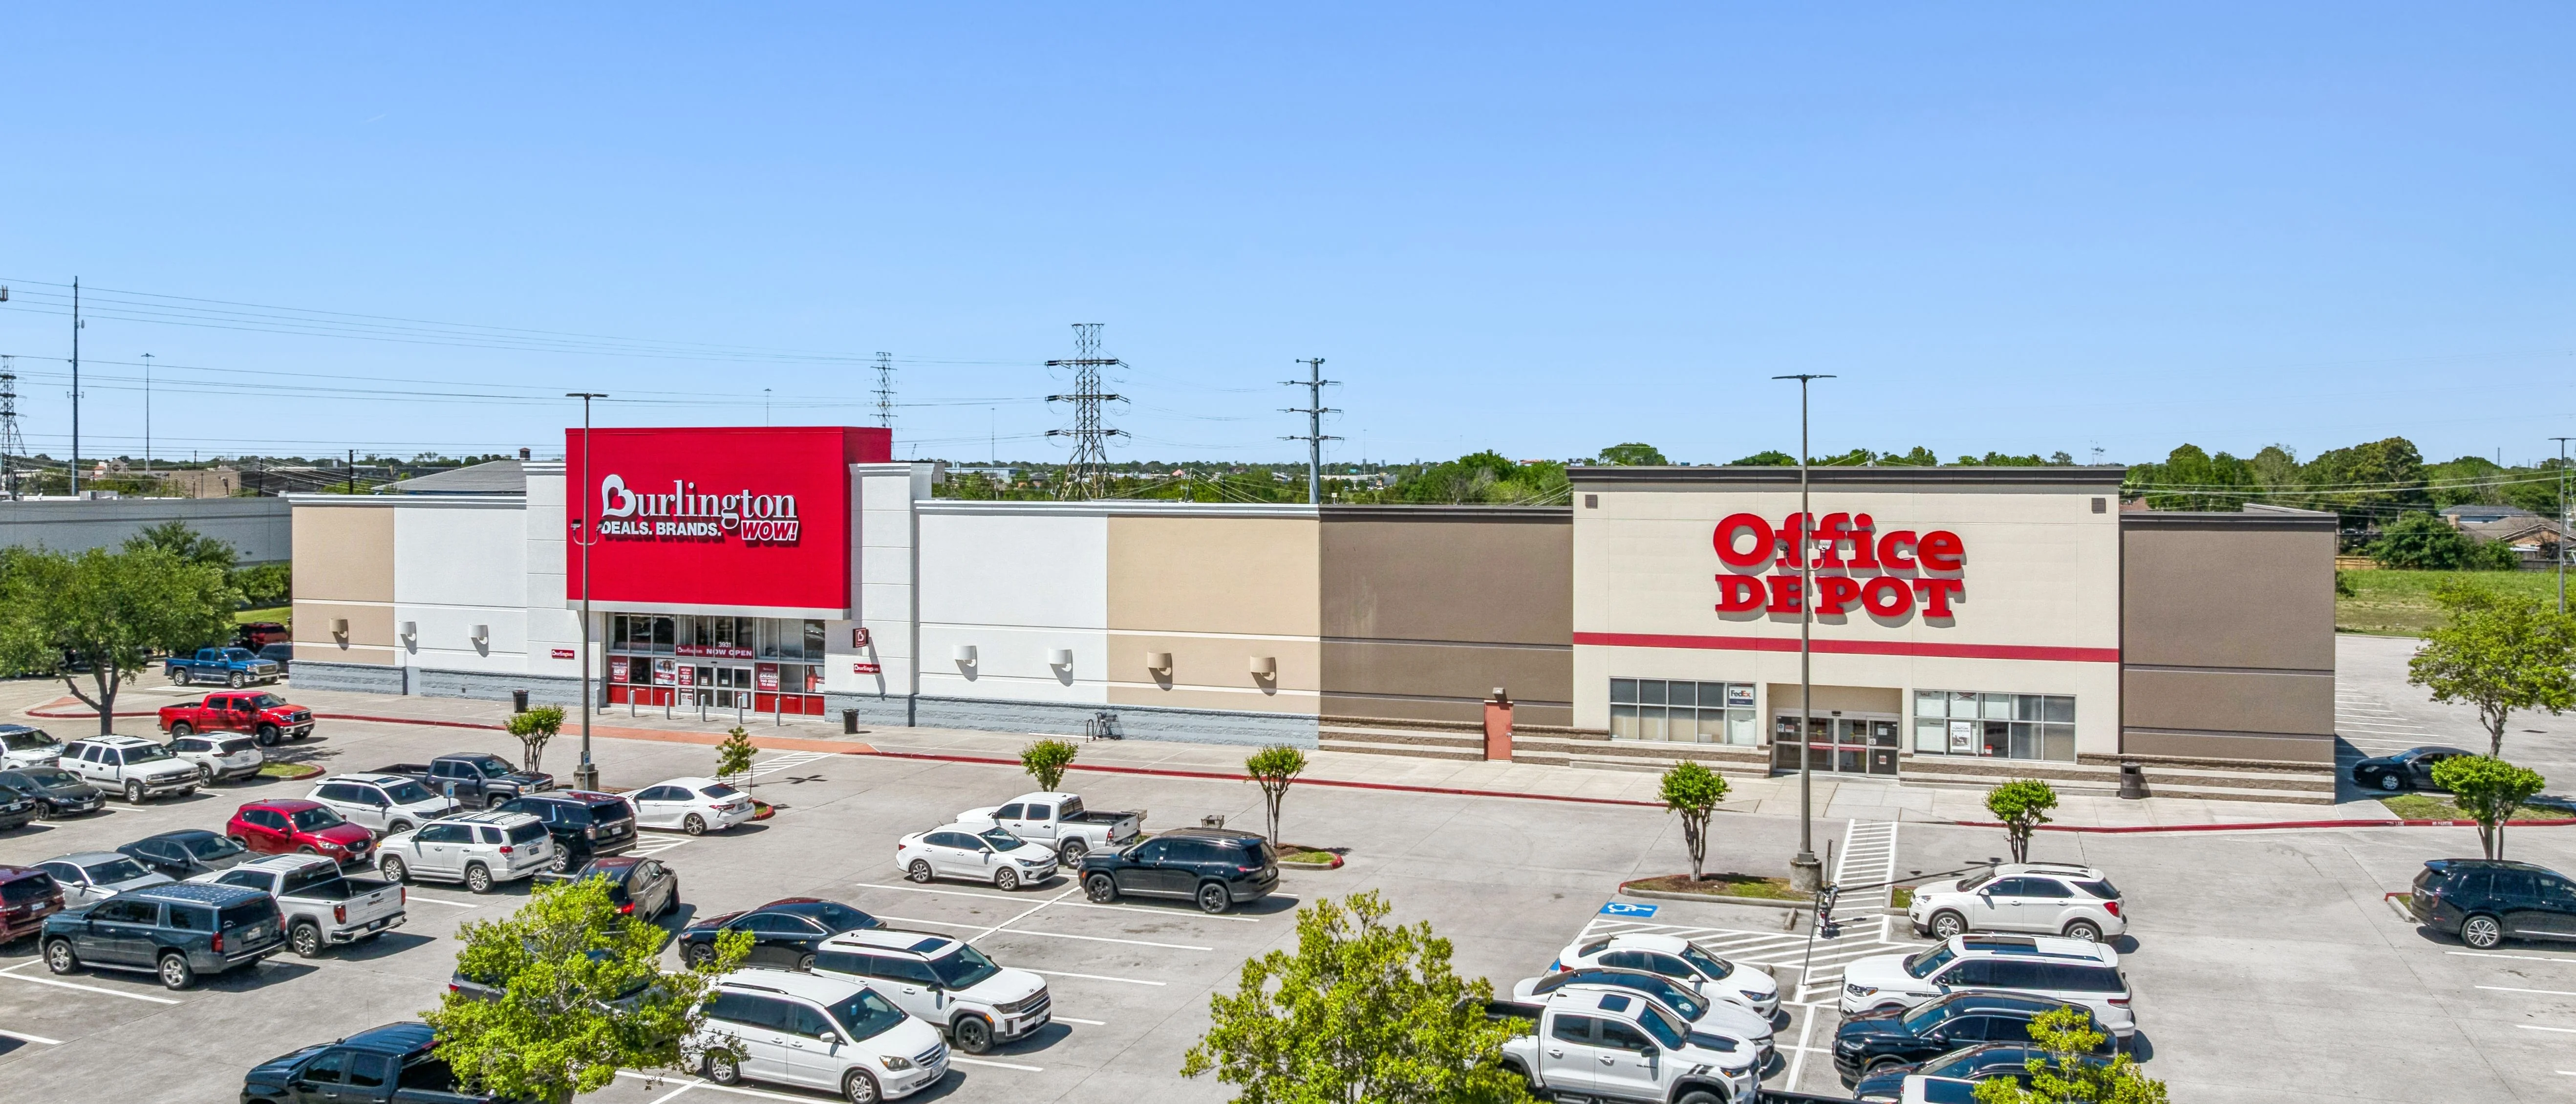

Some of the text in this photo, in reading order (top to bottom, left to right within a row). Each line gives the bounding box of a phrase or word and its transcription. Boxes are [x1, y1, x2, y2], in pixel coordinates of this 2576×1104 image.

[601, 474, 797, 529] Burlington
[601, 520, 799, 541] DEALS. BRANDS. WOW!
[1713, 512, 1964, 571] Office
[1715, 574, 1962, 617] DEPOT
